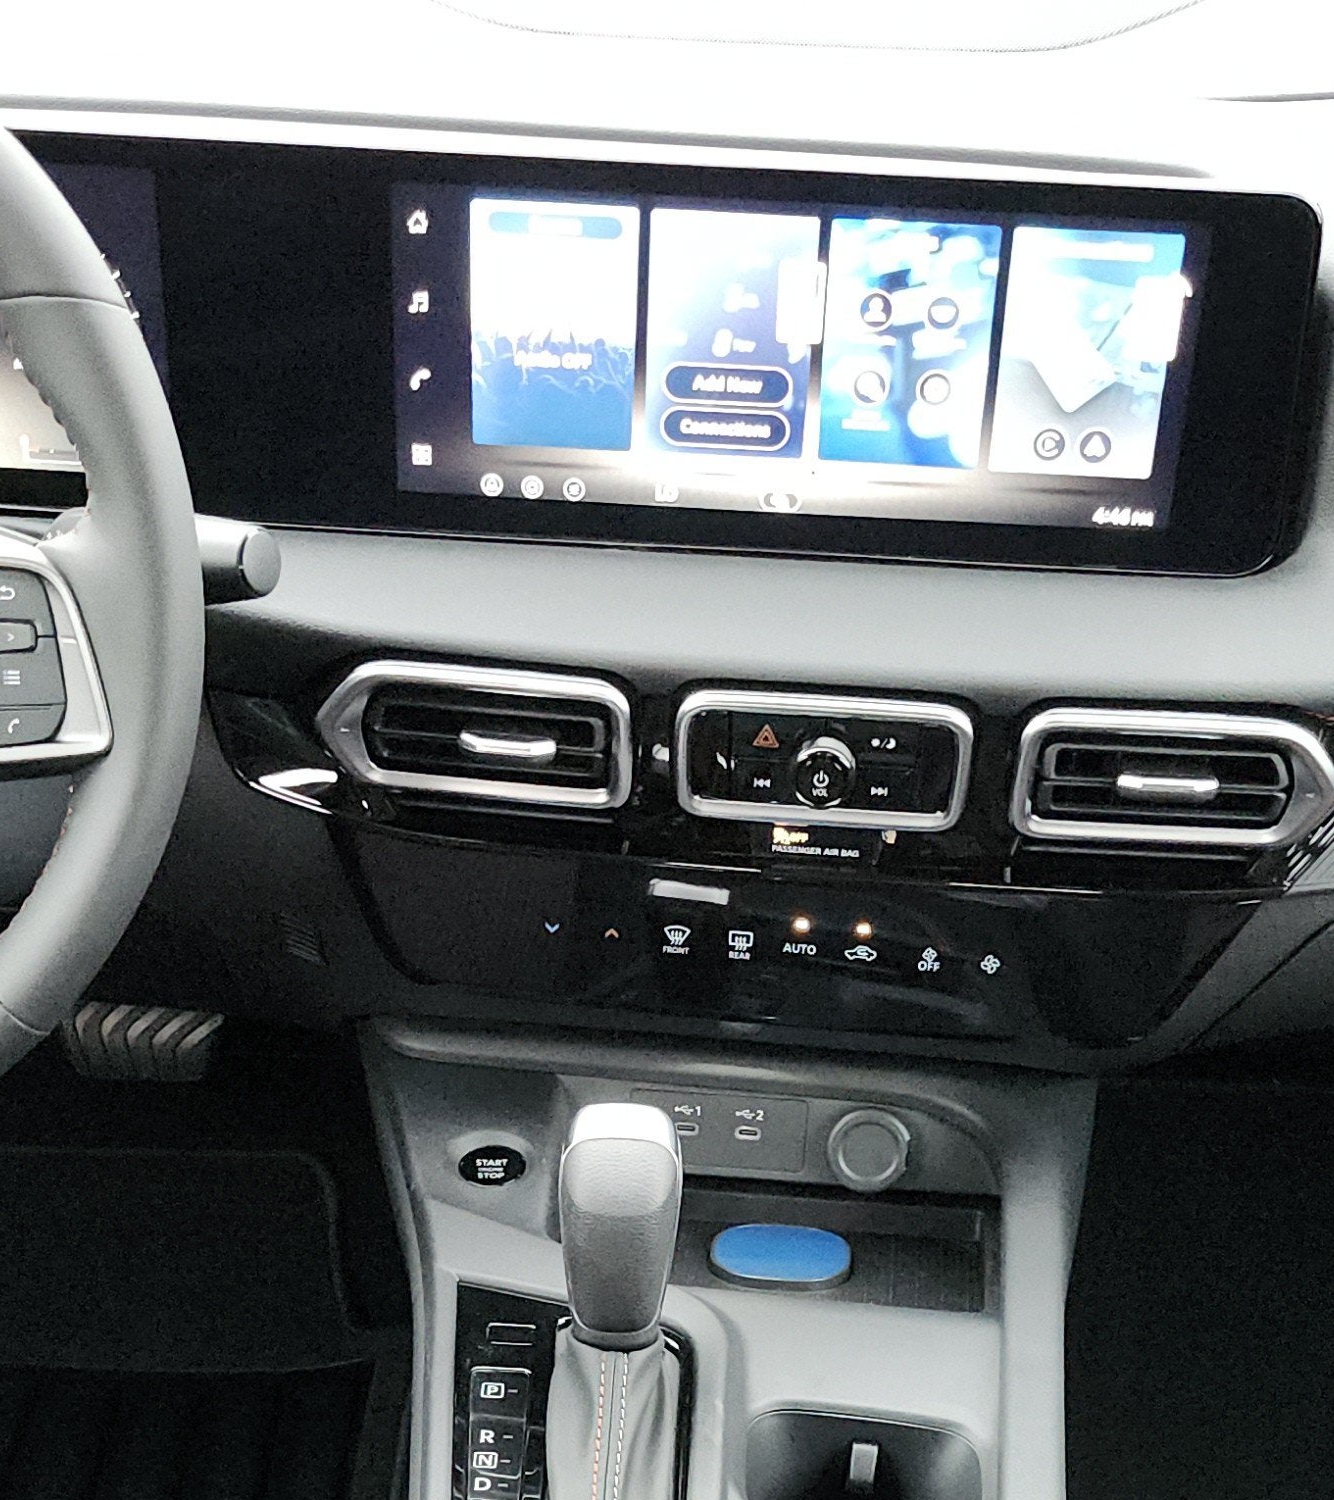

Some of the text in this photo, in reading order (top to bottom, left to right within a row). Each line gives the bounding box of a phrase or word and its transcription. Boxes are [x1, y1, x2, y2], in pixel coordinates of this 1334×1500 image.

[812, 788, 828, 798] VOL
[772, 844, 860, 858] PASSENGER AIR BAG
[663, 946, 689, 955] FRONT
[782, 943, 817, 955] AUTO
[729, 951, 750, 960] REAR
[918, 961, 940, 972] OFF
[695, 1106, 701, 1116] 1
[756, 1110, 764, 1121] 2
[475, 1159, 508, 1167] START
[479, 1429, 495, 1443] R
[478, 1455, 493, 1466] N
[474, 1477, 492, 1491] D
